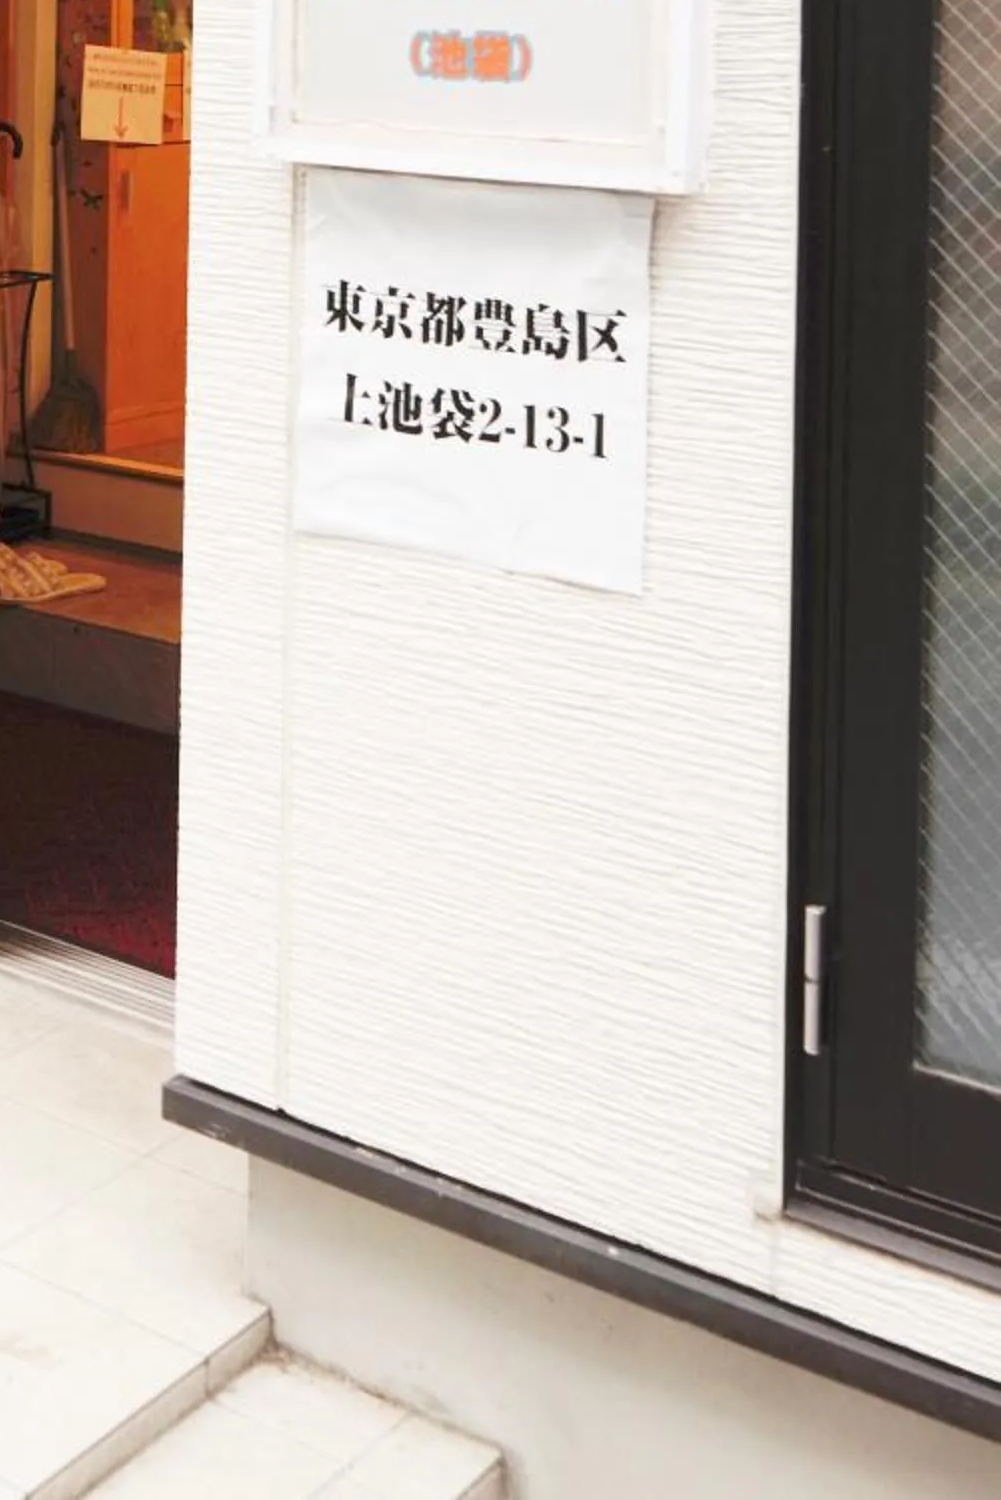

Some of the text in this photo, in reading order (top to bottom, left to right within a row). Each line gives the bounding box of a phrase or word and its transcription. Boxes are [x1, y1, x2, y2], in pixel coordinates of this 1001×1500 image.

[322, 279, 627, 362] 東京都豊島区
[332, 373, 607, 458] 上池袋2-13-1
